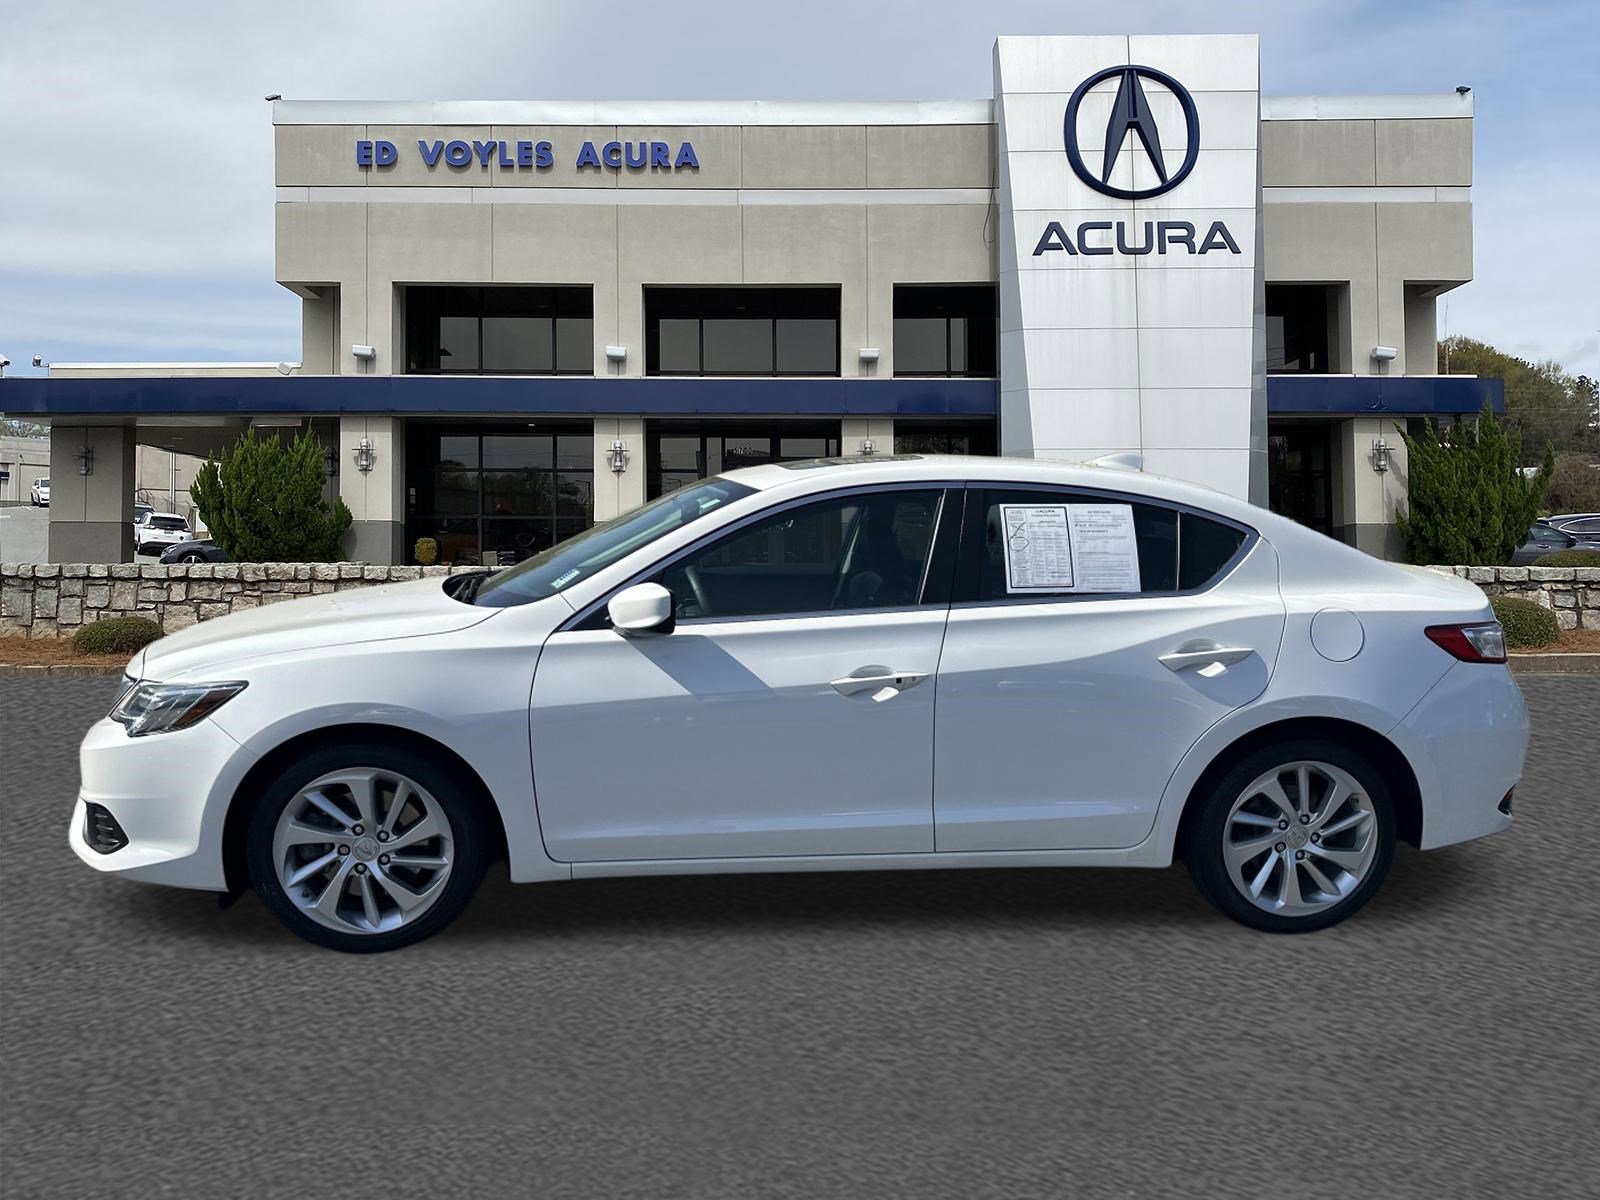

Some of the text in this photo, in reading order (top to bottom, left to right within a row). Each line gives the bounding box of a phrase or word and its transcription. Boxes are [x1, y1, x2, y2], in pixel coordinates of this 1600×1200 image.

[356, 140, 700, 169] ED VOYLES ACURA
[1032, 221, 1242, 256] ACURA
